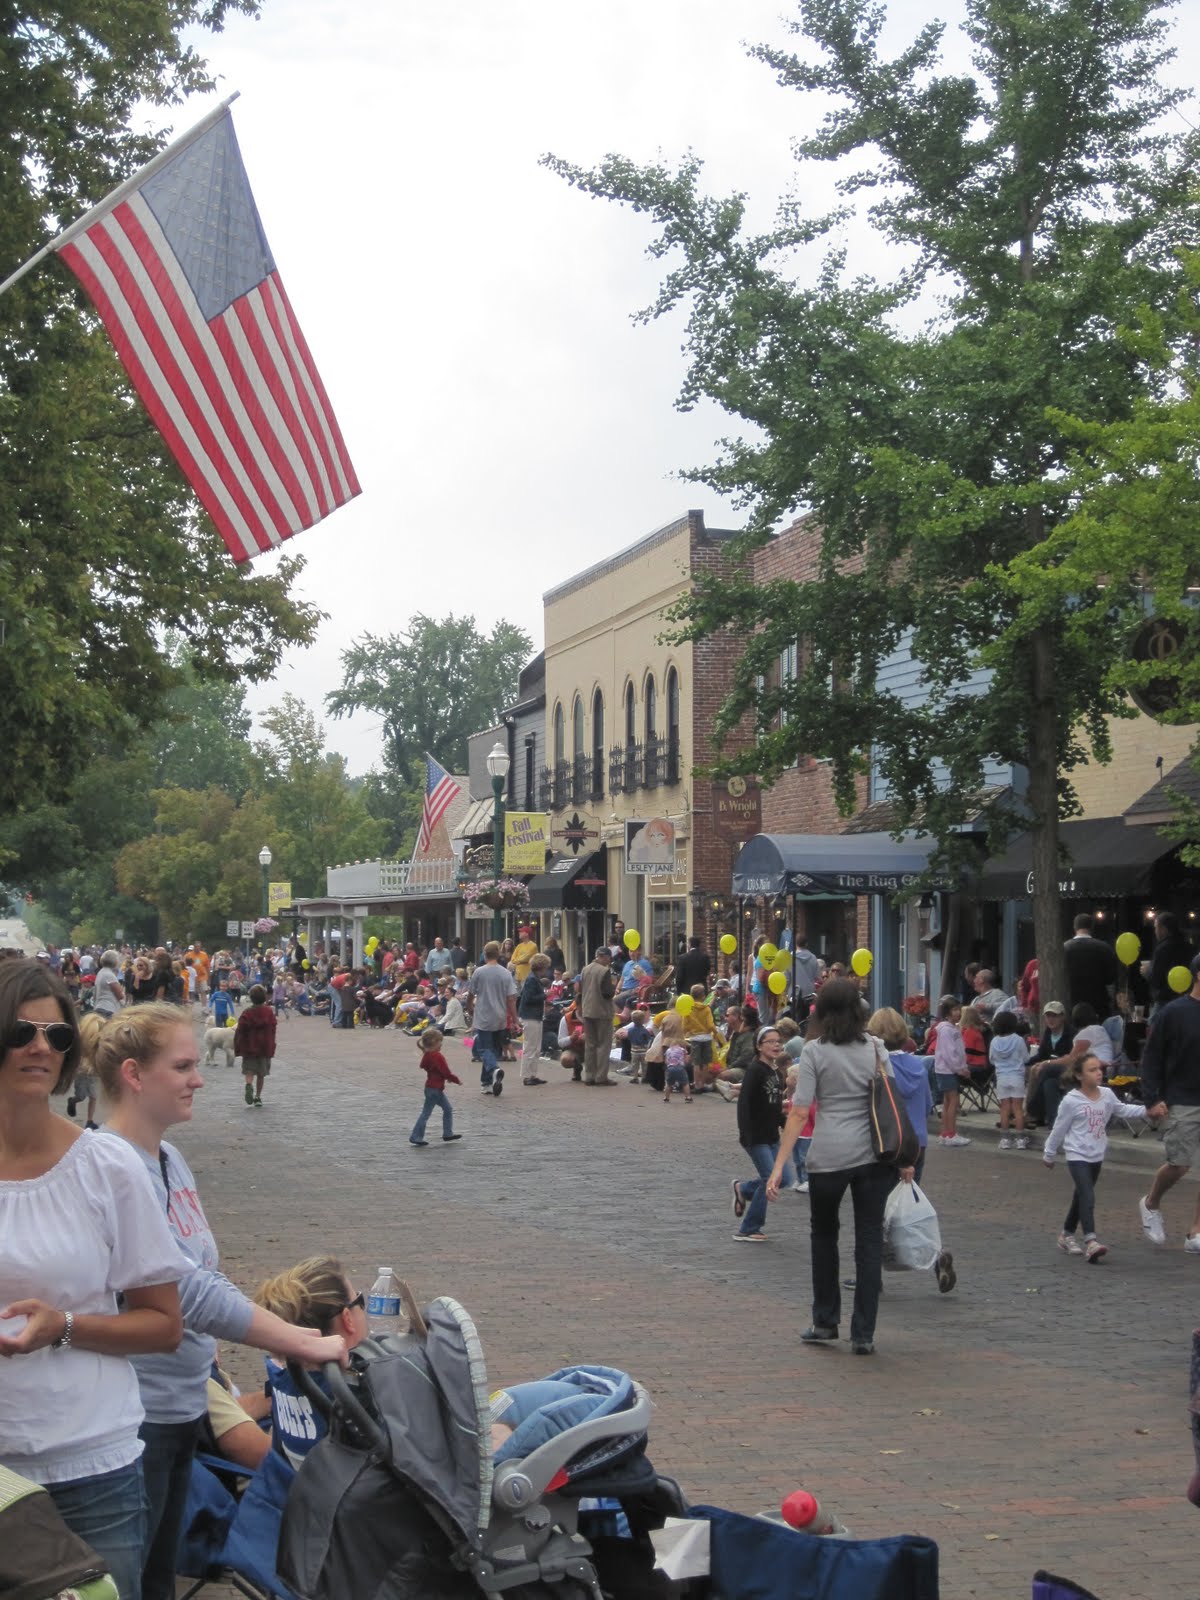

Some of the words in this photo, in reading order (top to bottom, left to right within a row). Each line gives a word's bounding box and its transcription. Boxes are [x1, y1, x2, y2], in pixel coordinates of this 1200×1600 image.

[512, 817, 531, 833] Fall
[506, 827, 545, 847] Festival
[627, 864, 653, 872] LESLEY
[655, 864, 674, 873] JANE
[836, 874, 864, 887] The
[868, 874, 898, 890] Rug
[272, 1386, 317, 1440] COLTS
